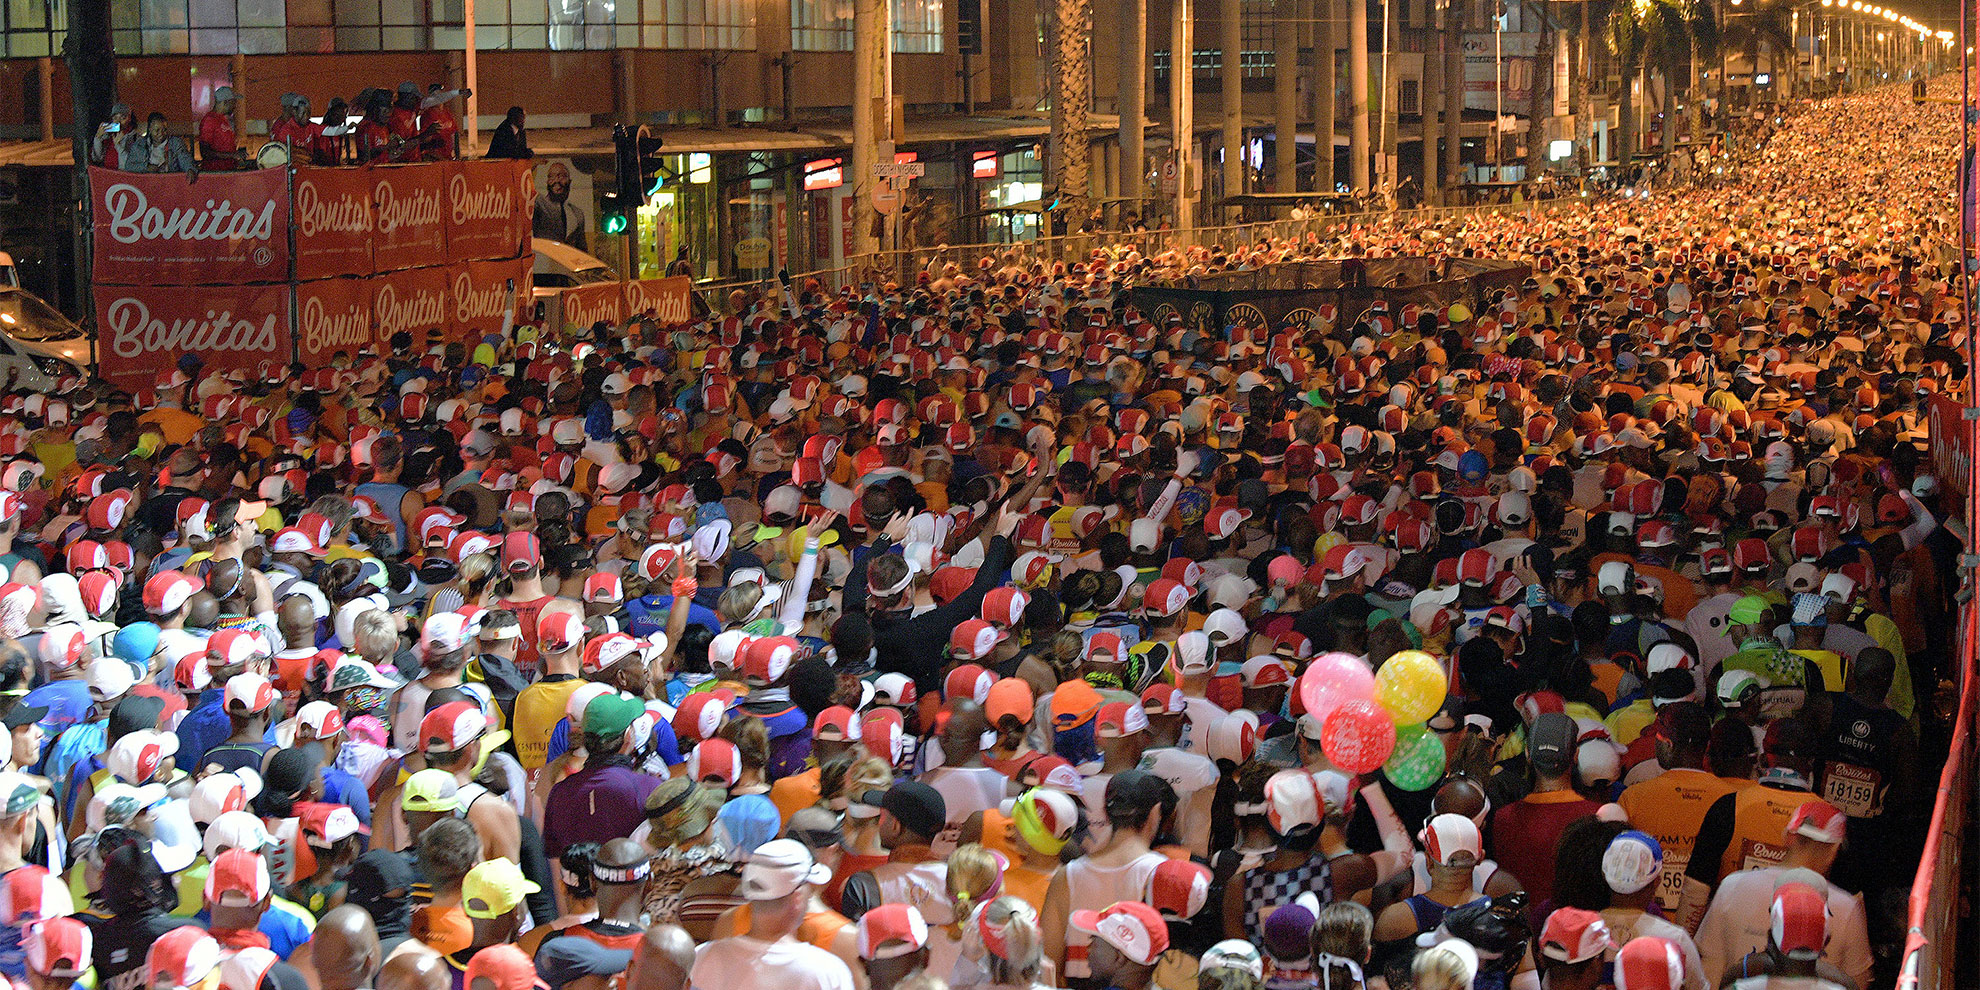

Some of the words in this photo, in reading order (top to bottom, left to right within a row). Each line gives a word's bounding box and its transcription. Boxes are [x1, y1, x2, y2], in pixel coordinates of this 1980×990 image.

[105, 183, 277, 244] Bonitas
[298, 180, 373, 238] Bonitas
[375, 180, 441, 235] Bonitas
[450, 174, 511, 226] Bonitas
[107, 297, 277, 358] Bonitas
[304, 296, 369, 355] Bonitas
[377, 283, 445, 343] Bonitas
[1839, 734, 1876, 753] LIBERTY
[1829, 780, 1871, 803] 18159
[1835, 763, 1872, 782] Bonitas
